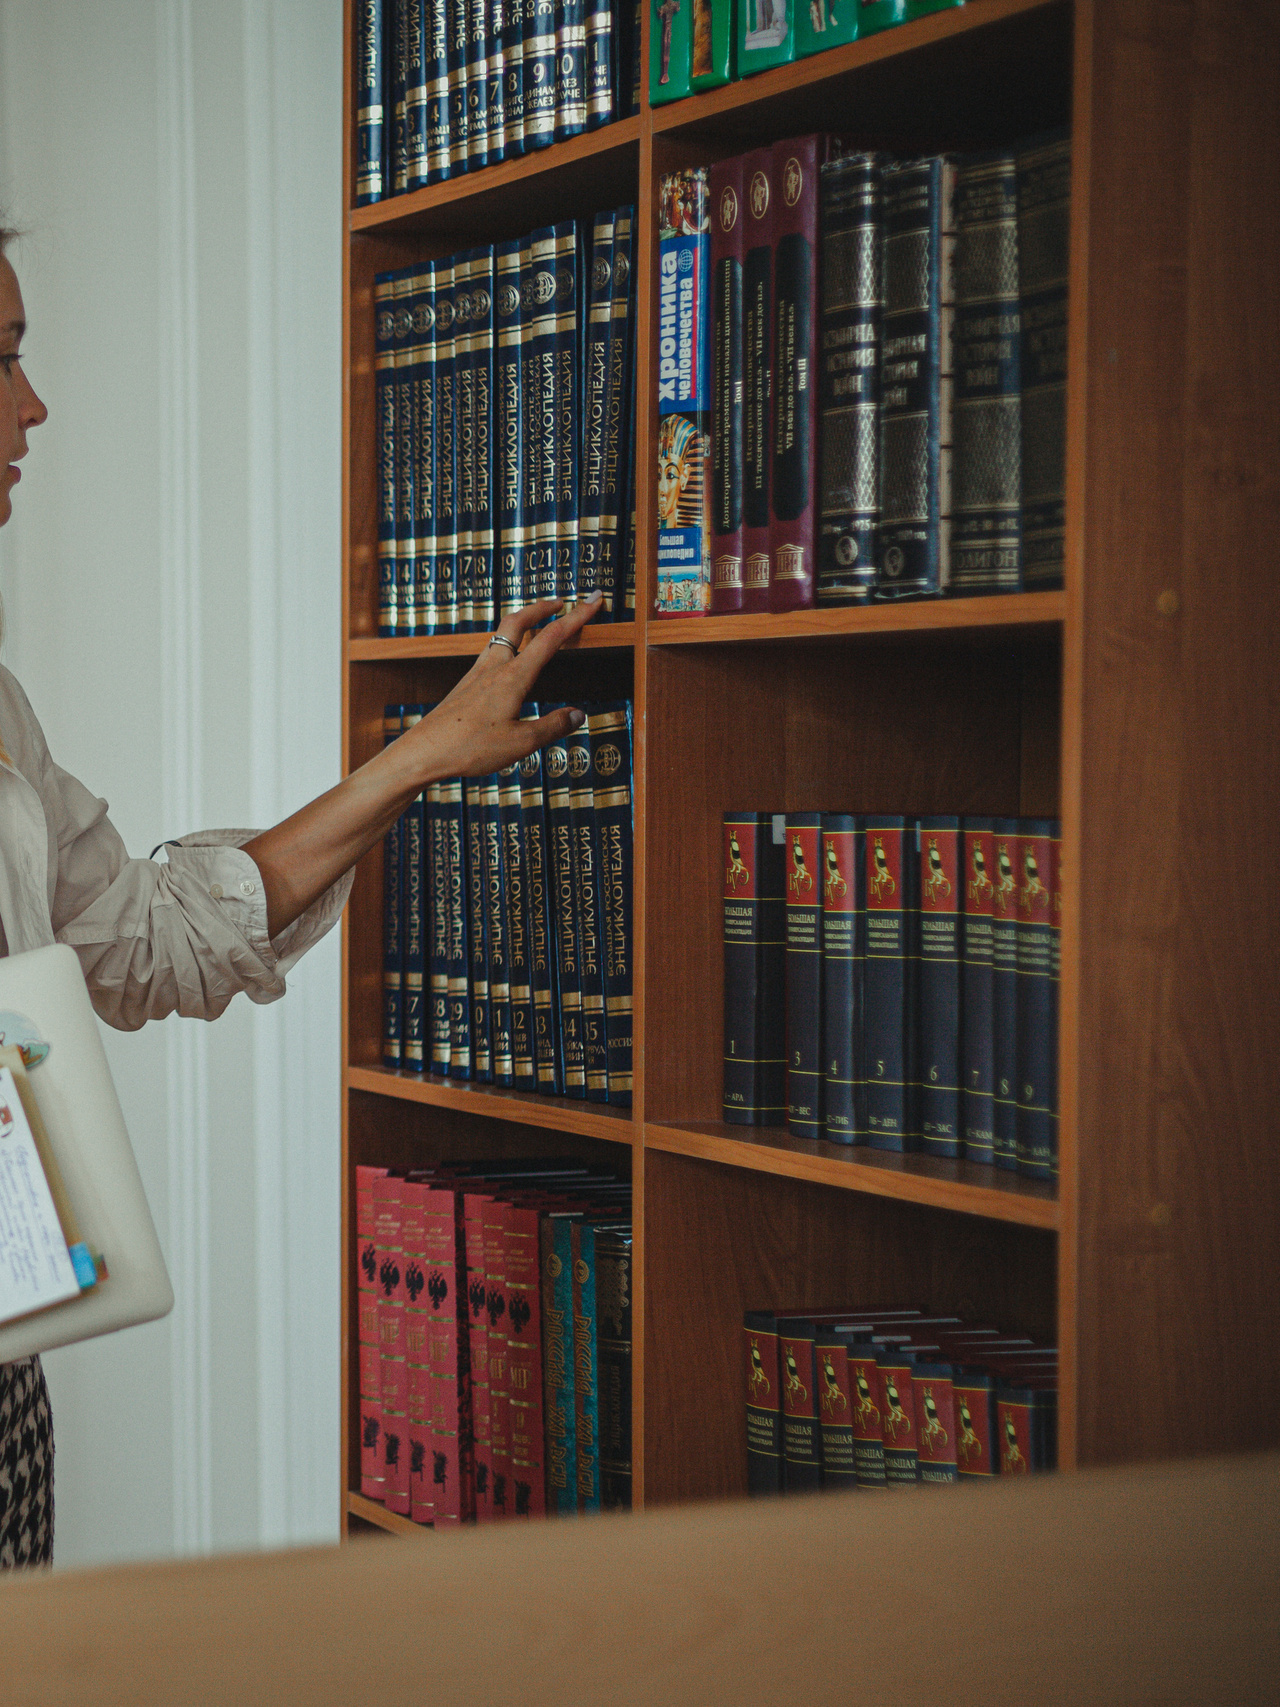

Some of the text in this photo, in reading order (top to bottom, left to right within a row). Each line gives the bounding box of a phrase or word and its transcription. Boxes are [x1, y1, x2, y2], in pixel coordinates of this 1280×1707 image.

[508, 72, 518, 92] 8
[533, 62, 545, 84] 9
[469, 88, 479, 107] 6
[490, 81, 499, 101] 7
[454, 95, 463, 114] 5
[678, 277, 693, 401] человечества
[787, 324, 795, 344] век
[723, 338, 731, 377] начала
[798, 371, 808, 391] Том
[587, 341, 604, 497] ЭНЦИКЛОПЕДИЯ
[606, 338, 622, 494] ЭНЦИКЛОПЕДИЯ
[723, 389, 731, 434] времена
[787, 411, 795, 430] век
[542, 352, 555, 503] ЭНЦИКЛОПЕДИЯ
[562, 349, 572, 501] ЭНЦИКЛОПЕДИЯ
[777, 396, 785, 454] История
[442, 375, 452, 517] ЭНЦИКЛОПЕДИЯ
[461, 369, 472, 513] ЭНЦИКЛОПЕДИЯ
[477, 367, 488, 512] ЭНЦИКЛОПЕДИЯ
[506, 363, 517, 510] ЭНЦИКЛОПЕДИЯ
[421, 378, 432, 519] ЭНЦИКЛОПЕДИЯ
[723, 436, 731, 529] Доисторические
[538, 547, 552, 568] 21
[557, 547, 570, 567] 22
[580, 543, 595, 563] 23
[598, 542, 611, 561] 24
[417, 561, 430, 580] 15
[438, 560, 451, 579] 16
[460, 556, 472, 575] 17
[474, 555, 486, 575] 18
[501, 553, 516, 573] 19
[409, 817, 419, 956] ЭНЦИКЛОПЕДИЯ
[449, 818, 463, 960] ЭНЦИКЛОПЕДИЯ
[471, 821, 482, 964] ЭНЦИКЛОПЕДИЯ
[486, 821, 502, 965] ЭНЦИКЛОПЕДИЯ
[507, 821, 524, 967] ЭНЦИКЛОПЕДИЯ
[530, 824, 545, 970] ЭНЦИКЛОПЕДИЯ
[557, 825, 574, 973] ЭНЦИКЛОПЕДИЯ
[579, 825, 596, 975] ЭНЦИКЛОПЕДИЯ
[601, 826, 614, 977] БОЛЬШАЯ РОССИЙСКАЯ
[609, 824, 625, 975] ЭНЦИКЛОПЕДИЯ
[824, 920, 851, 930] ОЛЬШАЯ
[731, 1040, 735, 1054] 1
[795, 1051, 801, 1066] 3
[831, 1060, 837, 1075] 4
[877, 1060, 884, 1076] 5
[930, 1065, 937, 1081] 6
[972, 1070, 979, 1086] 7
[1001, 1079, 1009, 1095] 8
[1025, 1085, 1033, 1100] 9
